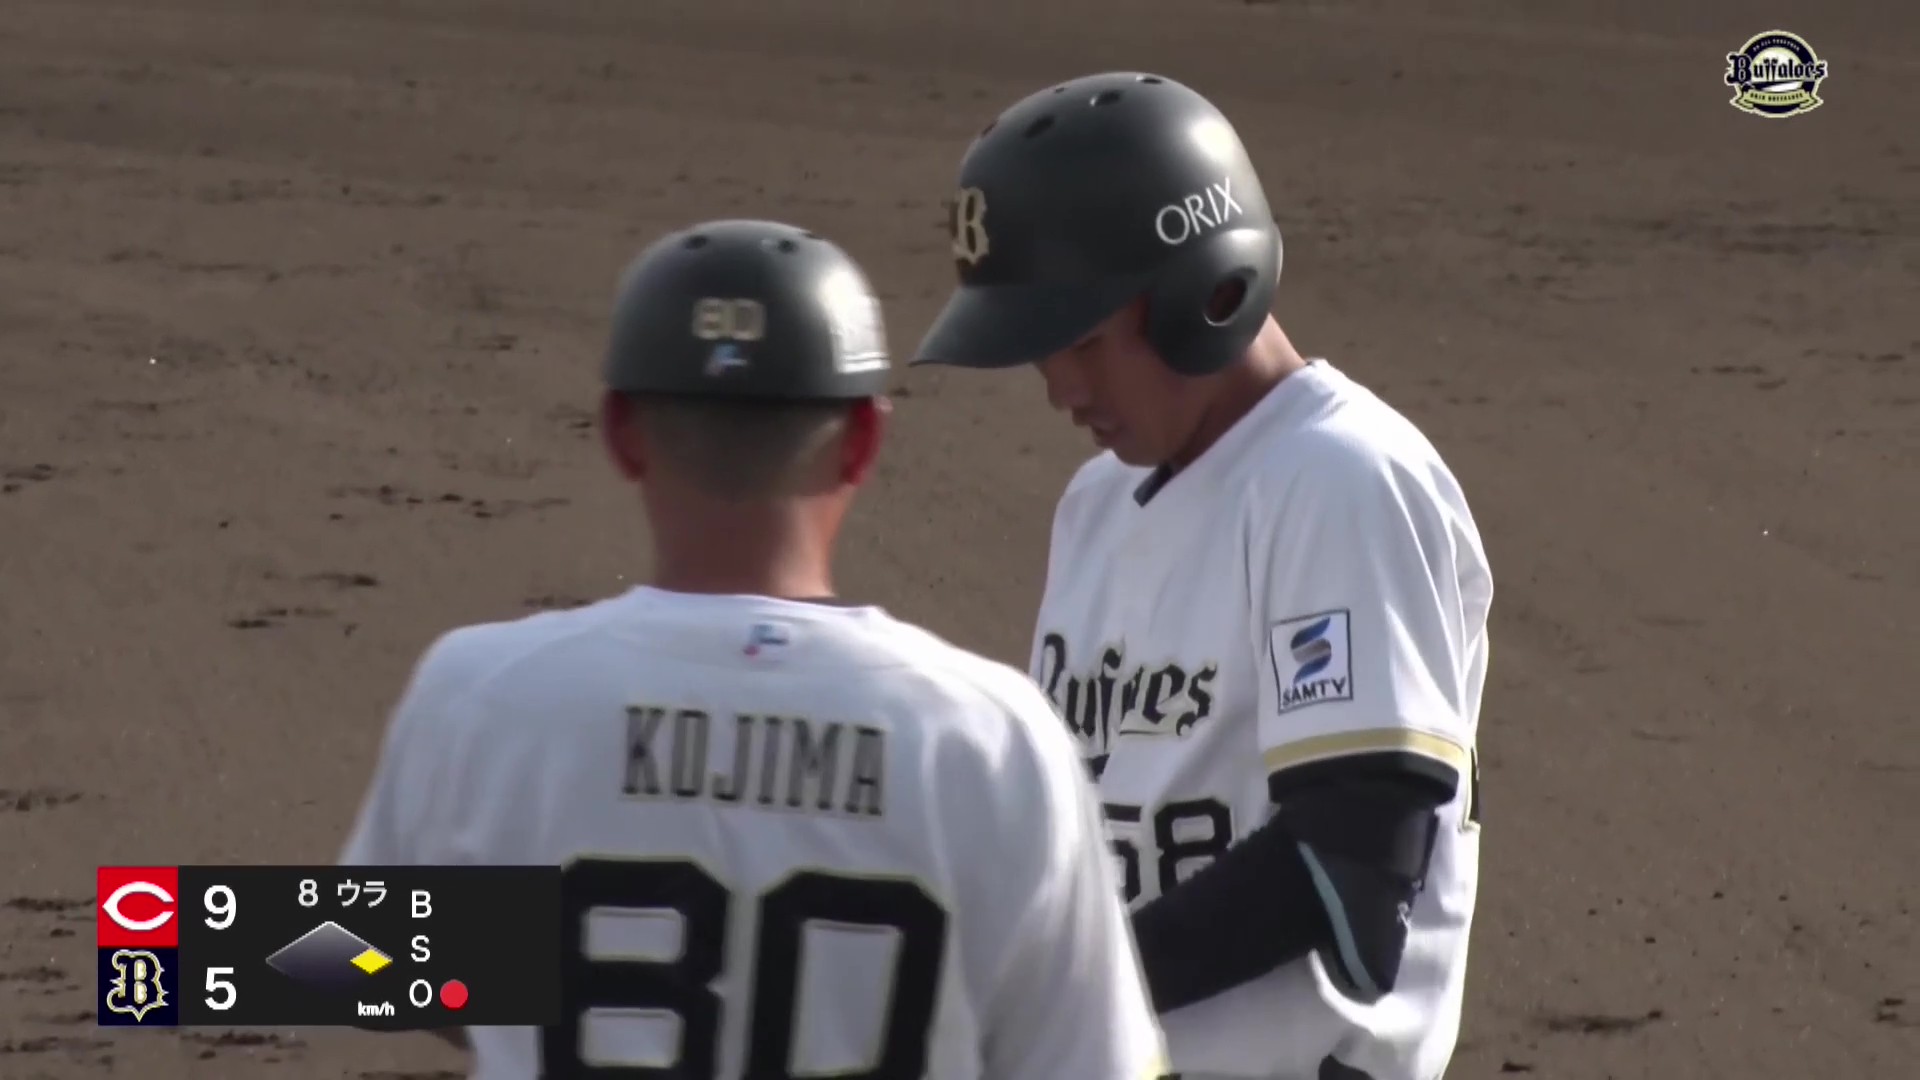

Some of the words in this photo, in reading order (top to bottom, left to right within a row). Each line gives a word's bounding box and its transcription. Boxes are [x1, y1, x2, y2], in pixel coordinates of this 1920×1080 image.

[1155, 176, 1243, 245] ORIX
[692, 297, 767, 341] 80
[1281, 675, 1346, 707] SAMTY
[620, 705, 886, 818] KOJIMA
[540, 856, 949, 1080] 80
